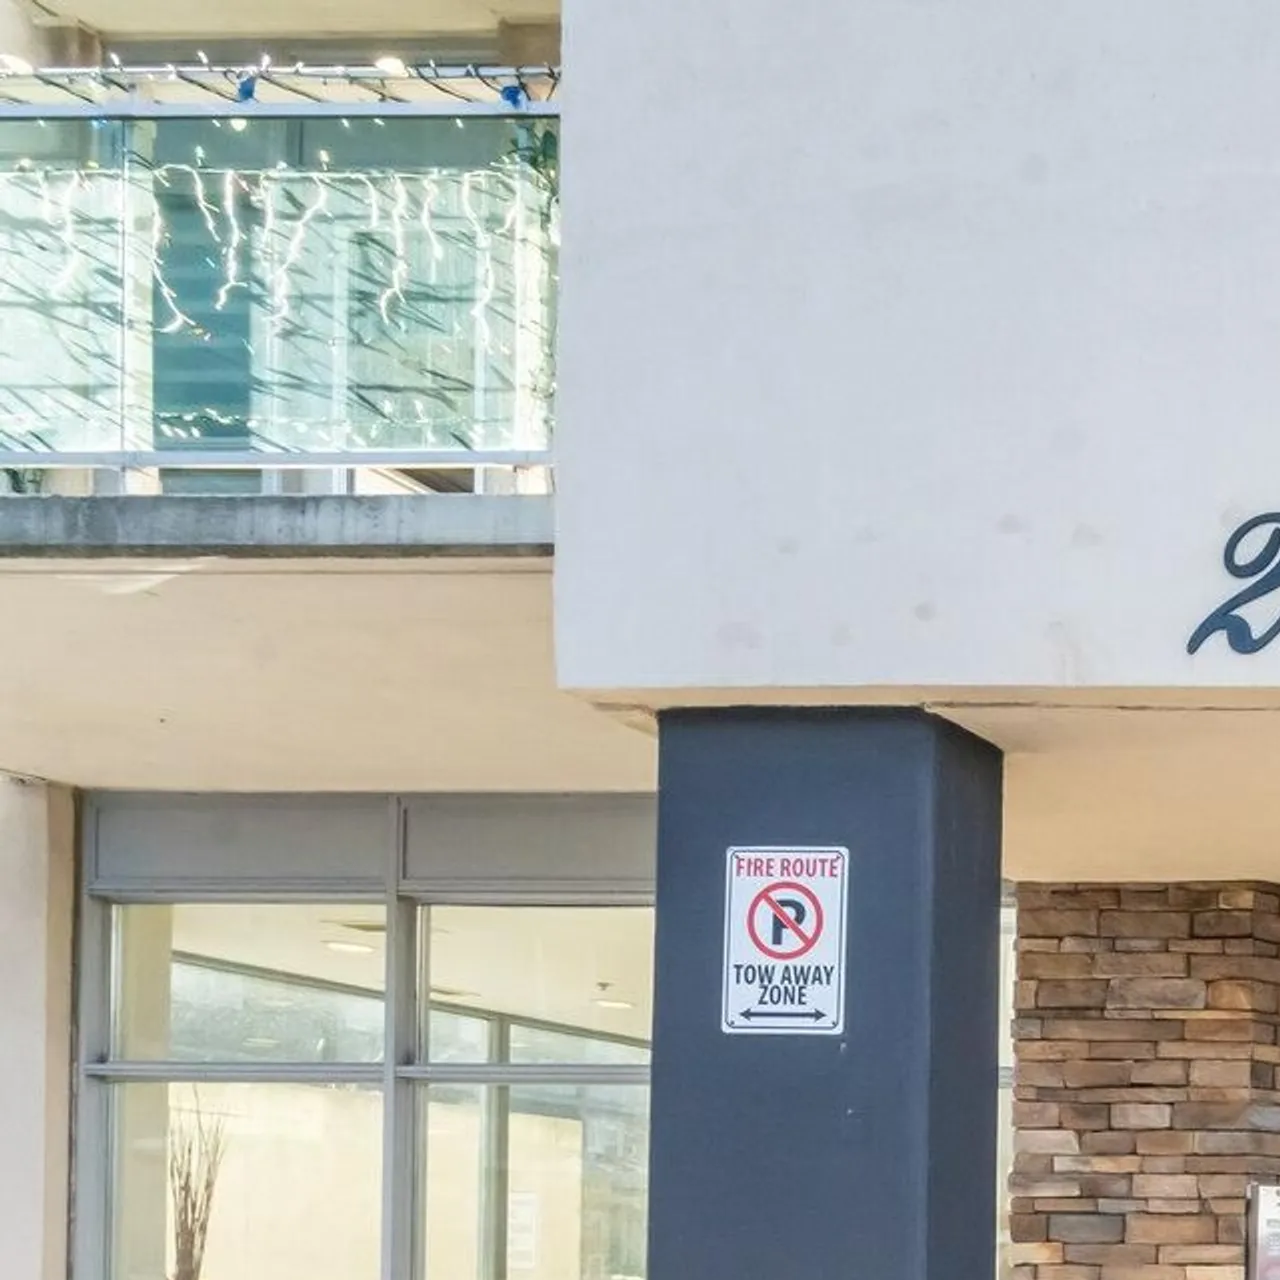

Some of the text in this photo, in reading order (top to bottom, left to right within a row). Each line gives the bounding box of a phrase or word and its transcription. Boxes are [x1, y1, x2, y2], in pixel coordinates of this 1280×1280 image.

[735, 857, 839, 878] FIRE ROUTE
[733, 964, 835, 986] TOW AWAY
[757, 985, 808, 1005] ZONE
